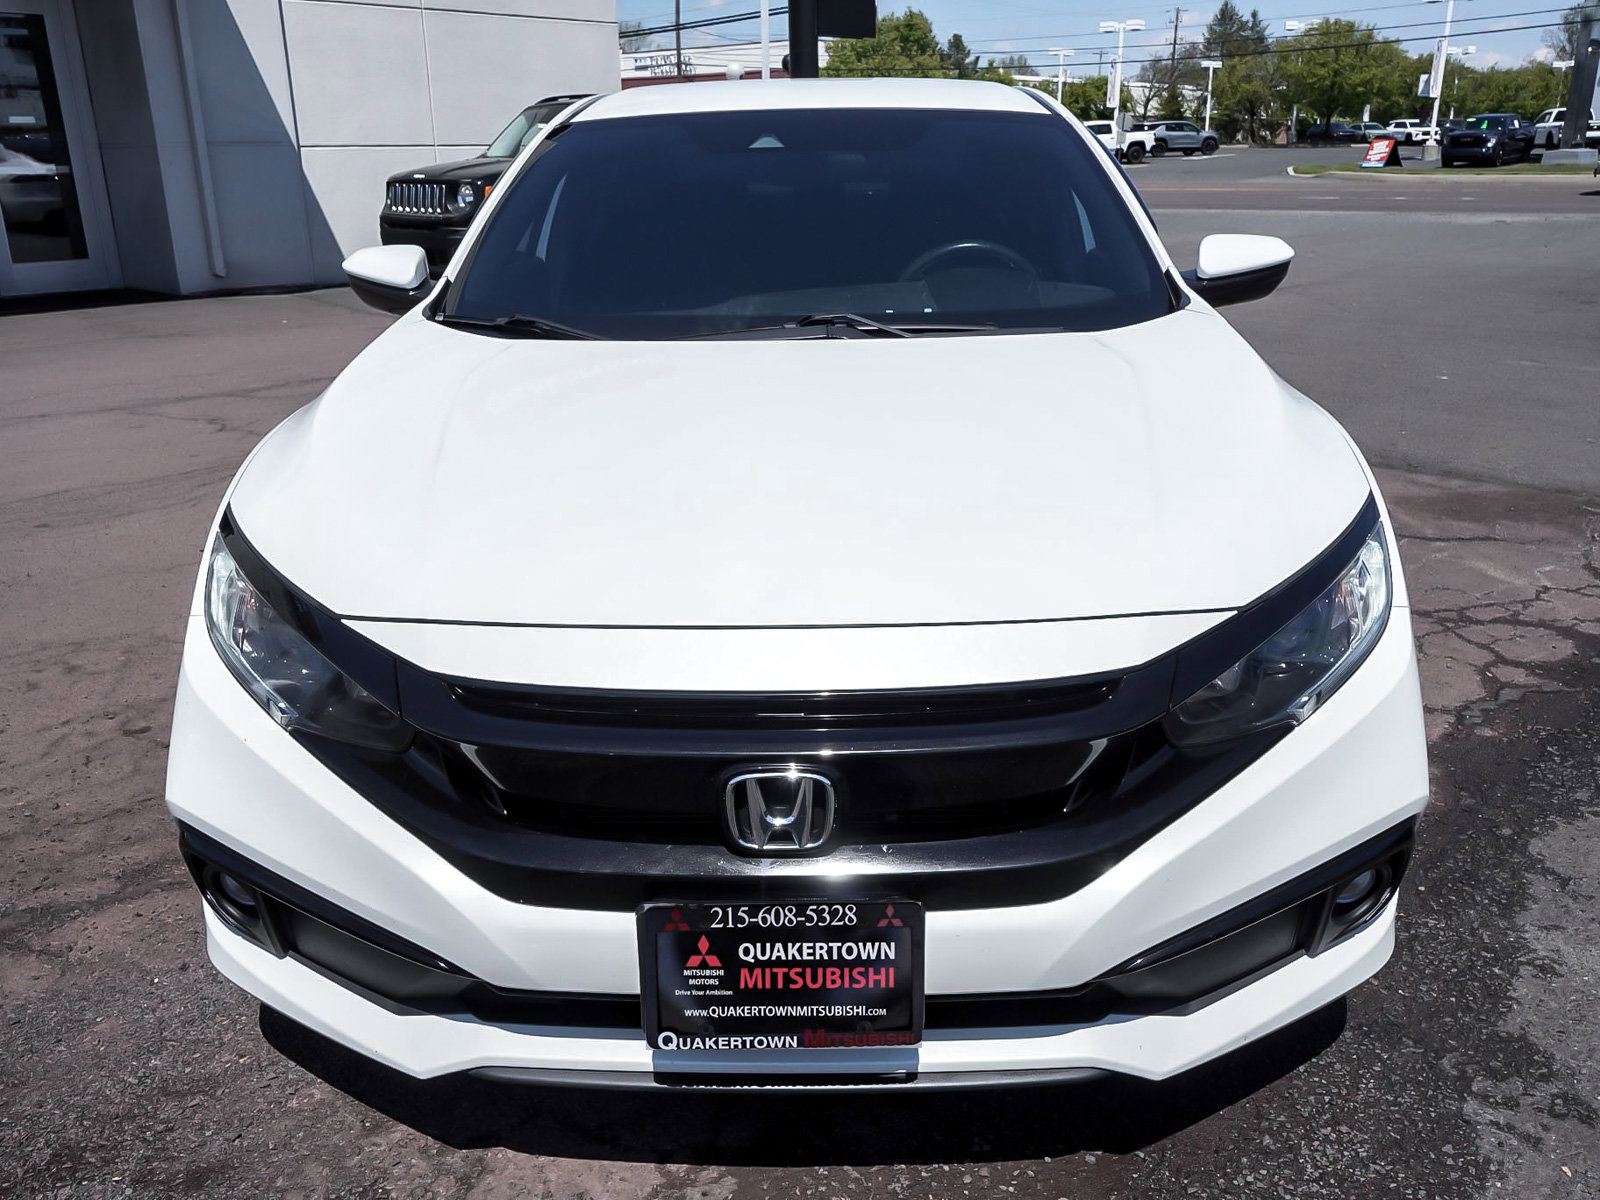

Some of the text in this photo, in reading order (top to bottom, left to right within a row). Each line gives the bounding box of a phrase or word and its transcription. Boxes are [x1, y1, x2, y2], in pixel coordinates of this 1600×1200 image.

[709, 904, 858, 929] 215-608-5328
[737, 942, 896, 963] QUAKERTOWN
[739, 966, 895, 990] MITSUBISHI
[657, 1029, 916, 1051] QUAKERTOWN MITSUBISHI
